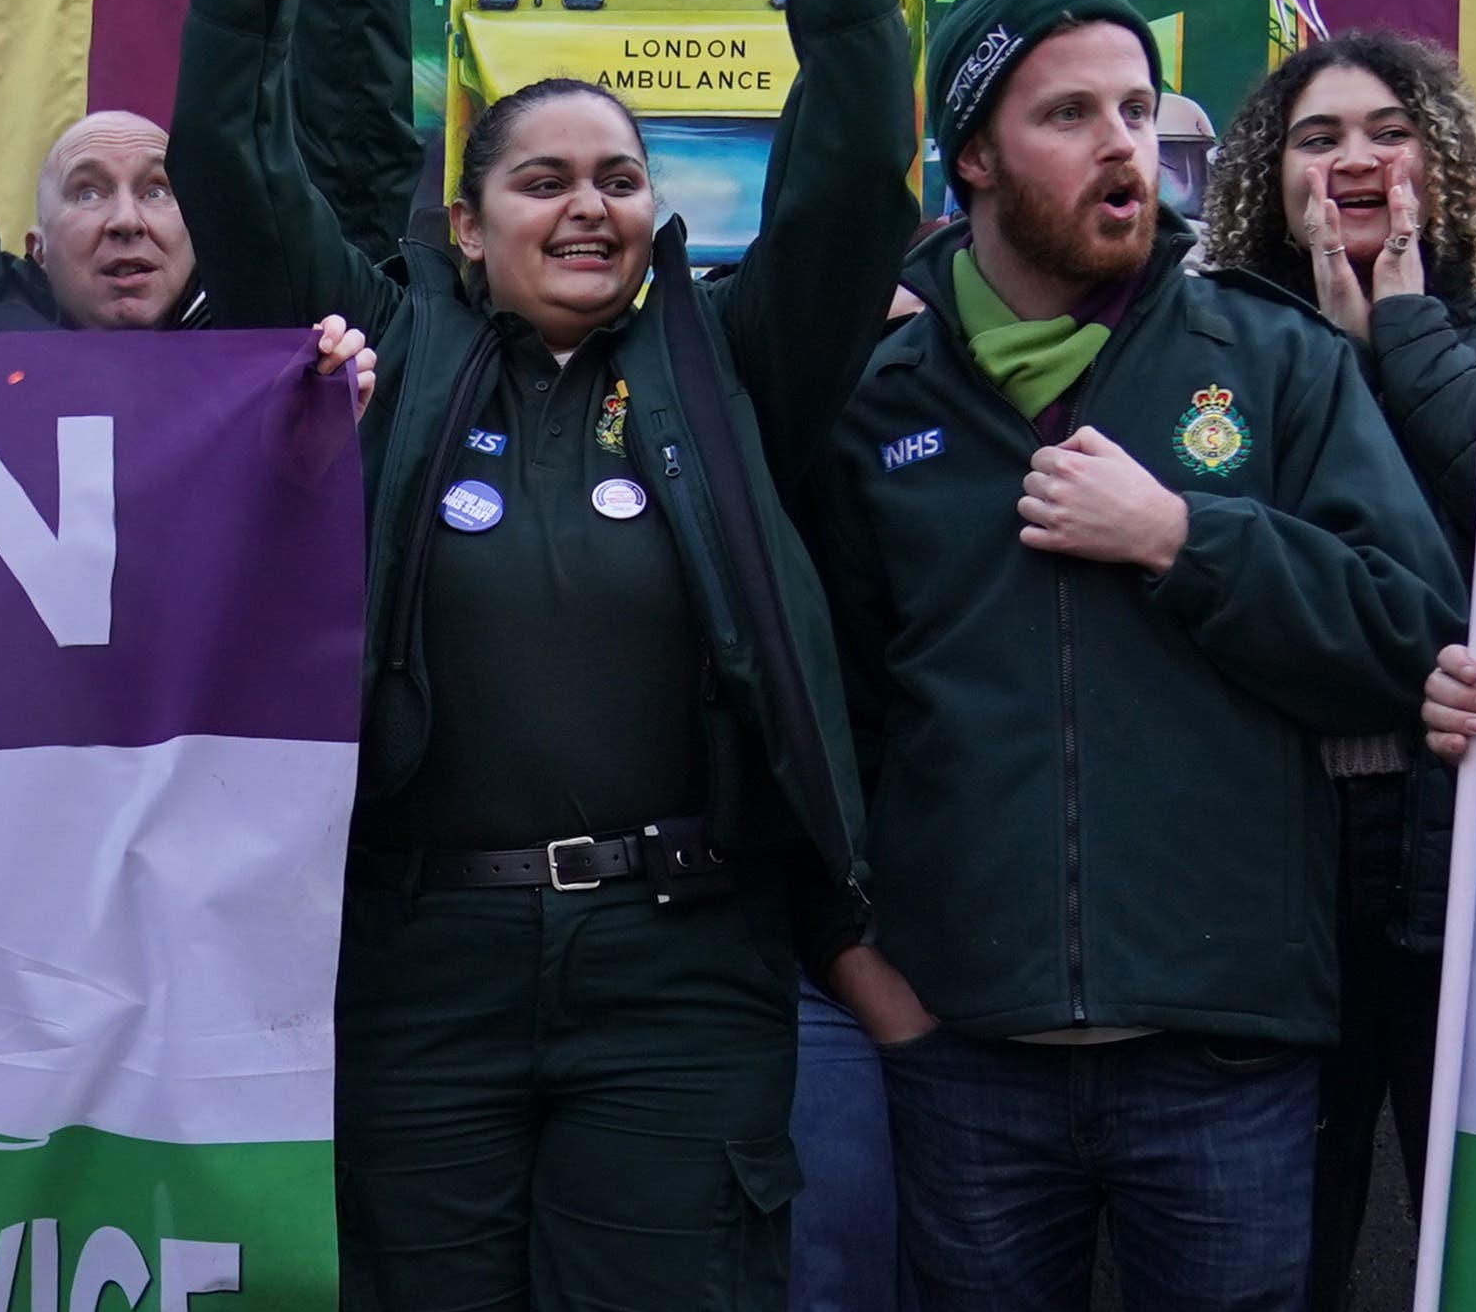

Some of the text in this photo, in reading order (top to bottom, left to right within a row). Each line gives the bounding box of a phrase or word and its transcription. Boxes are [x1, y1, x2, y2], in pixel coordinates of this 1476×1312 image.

[623, 39, 747, 61] LONDON
[954, 24, 1010, 111] UNISON
[598, 68, 771, 92] AMBULANCE
[885, 430, 938, 465] NHS
[463, 504, 493, 523] STAFF
